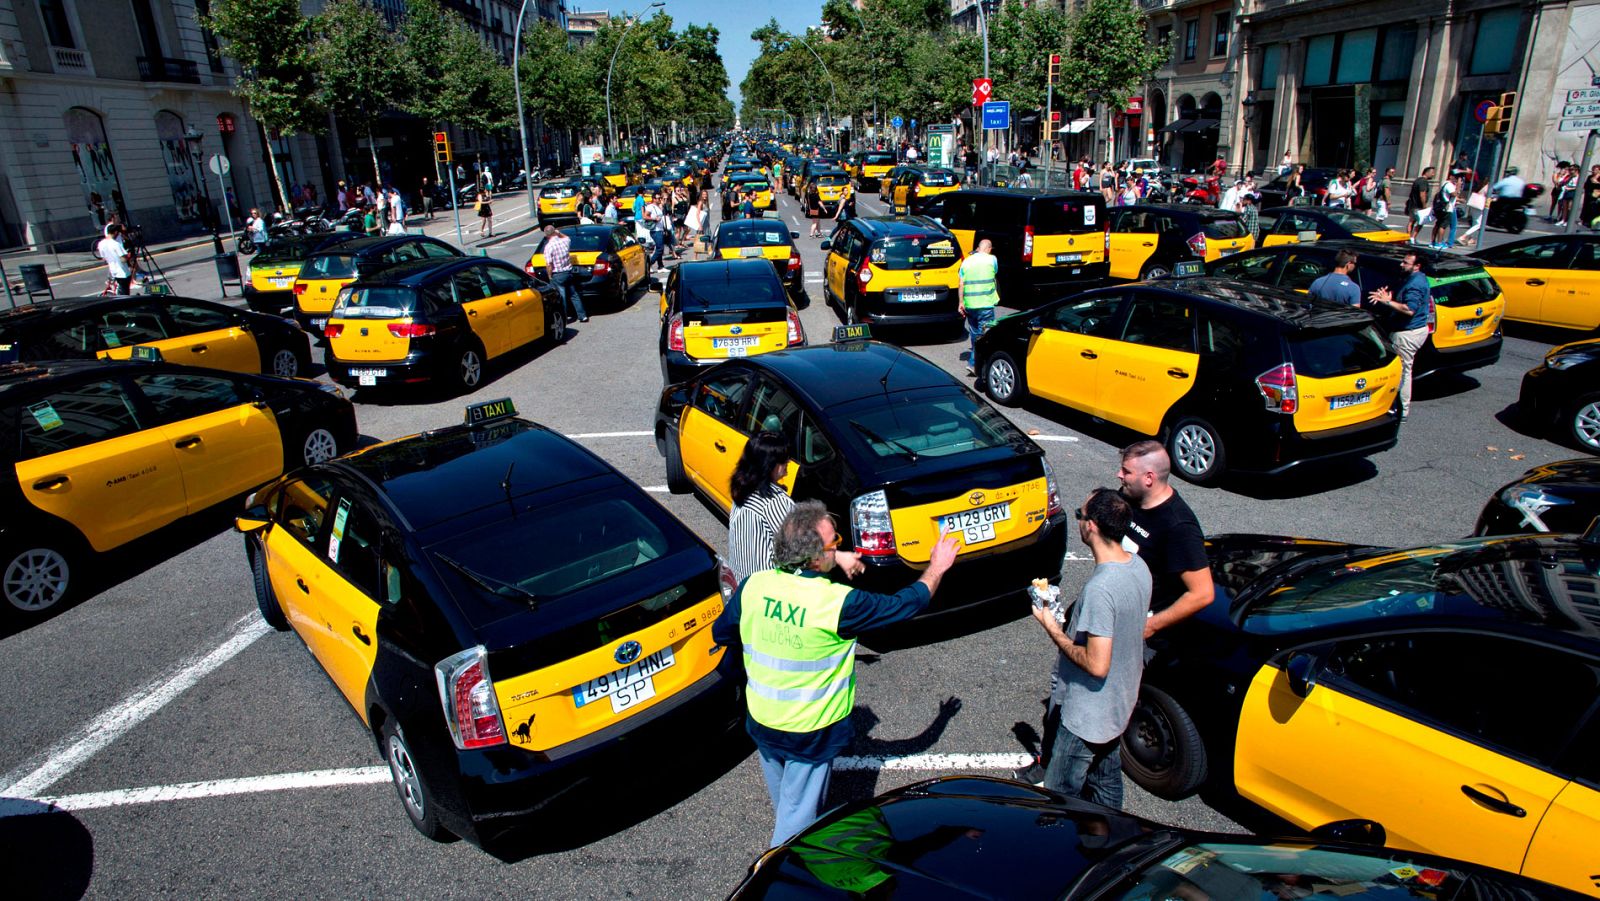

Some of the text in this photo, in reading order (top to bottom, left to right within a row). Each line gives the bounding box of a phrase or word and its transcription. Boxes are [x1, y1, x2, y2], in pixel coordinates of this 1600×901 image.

[1186, 265, 1199, 273] TAXI
[846, 327, 863, 338] TAXI
[718, 337, 758, 347] 7639 HRY
[138, 348, 150, 358] TAXI
[729, 347, 745, 357] SP
[361, 376, 375, 384] SP
[1336, 394, 1355, 408] 1552
[483, 402, 506, 418] TAXI
[947, 511, 980, 530] 8129
[983, 504, 1007, 522] GRV
[967, 523, 990, 541] SP
[701, 604, 721, 622] 9862
[763, 596, 806, 628] TAXI
[587, 650, 671, 698] 4917 HNL
[616, 679, 646, 707] SP
